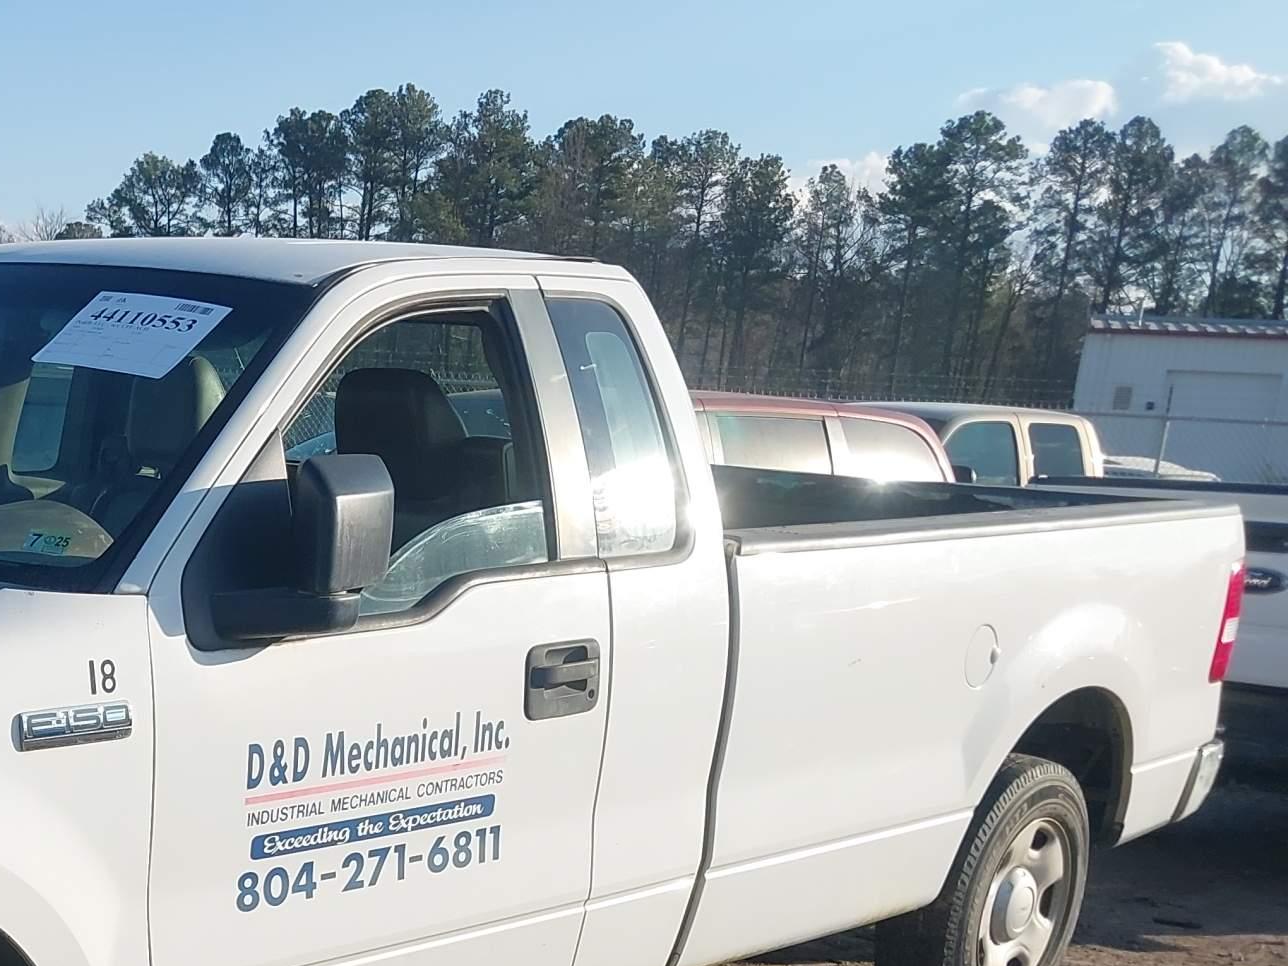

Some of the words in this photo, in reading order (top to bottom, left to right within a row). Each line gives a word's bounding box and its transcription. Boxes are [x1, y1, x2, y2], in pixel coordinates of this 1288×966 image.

[90, 307, 199, 333] 44110553
[29, 533, 44, 547] 7
[54, 536, 72, 547] 25
[88, 658, 117, 695] 18
[246, 736, 311, 790] D&D
[321, 711, 468, 778] Mechanical,
[473, 710, 510, 753] Inc.
[247, 801, 325, 827] INDUSTRIAL
[330, 786, 411, 813] MECHANICAL
[416, 769, 504, 798] CONTRACTORS
[263, 827, 351, 855] Exceeding
[356, 818, 385, 837] the
[388, 801, 485, 833] Expectation
[236, 824, 501, 912] 804-271-6811
